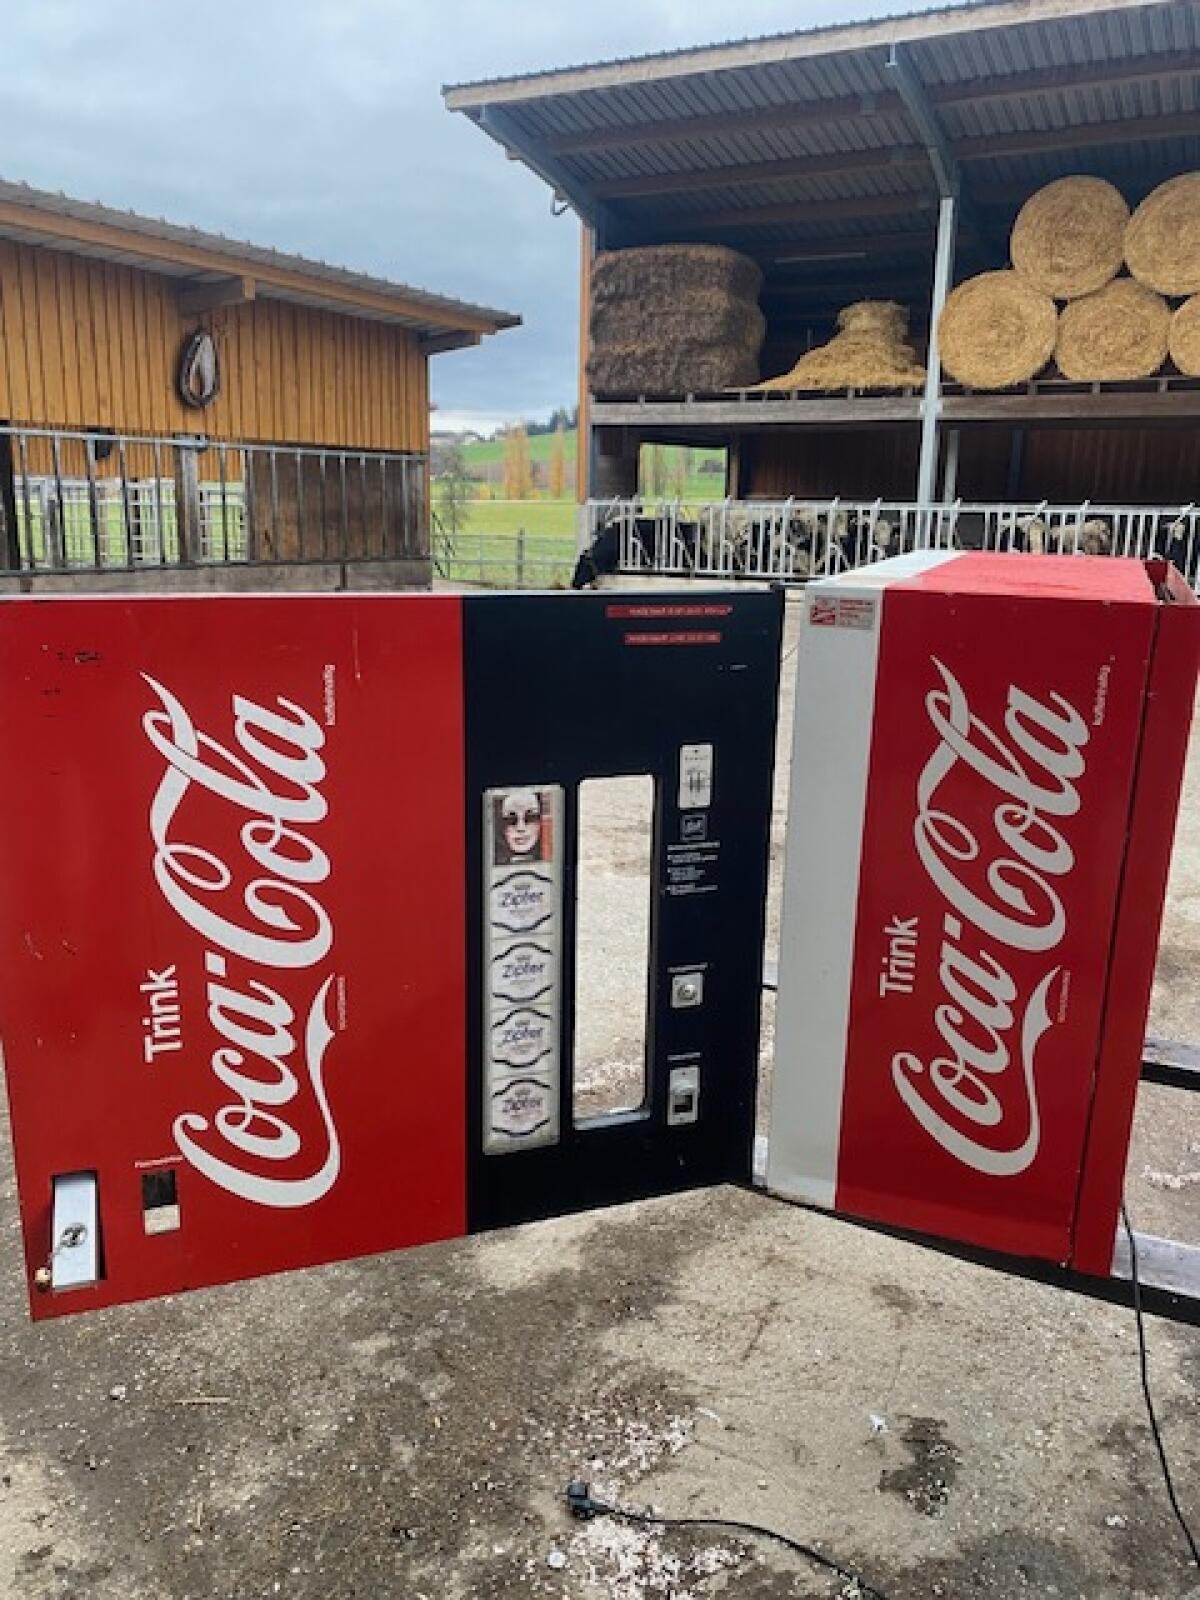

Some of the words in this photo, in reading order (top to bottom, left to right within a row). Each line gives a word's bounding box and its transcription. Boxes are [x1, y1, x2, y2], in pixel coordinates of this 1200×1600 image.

[140, 672, 341, 1208] Coca-Cola
[140, 964, 183, 1063] Trink
[880, 916, 919, 997] Trink
[891, 656, 1090, 1176] Coca-Cola
